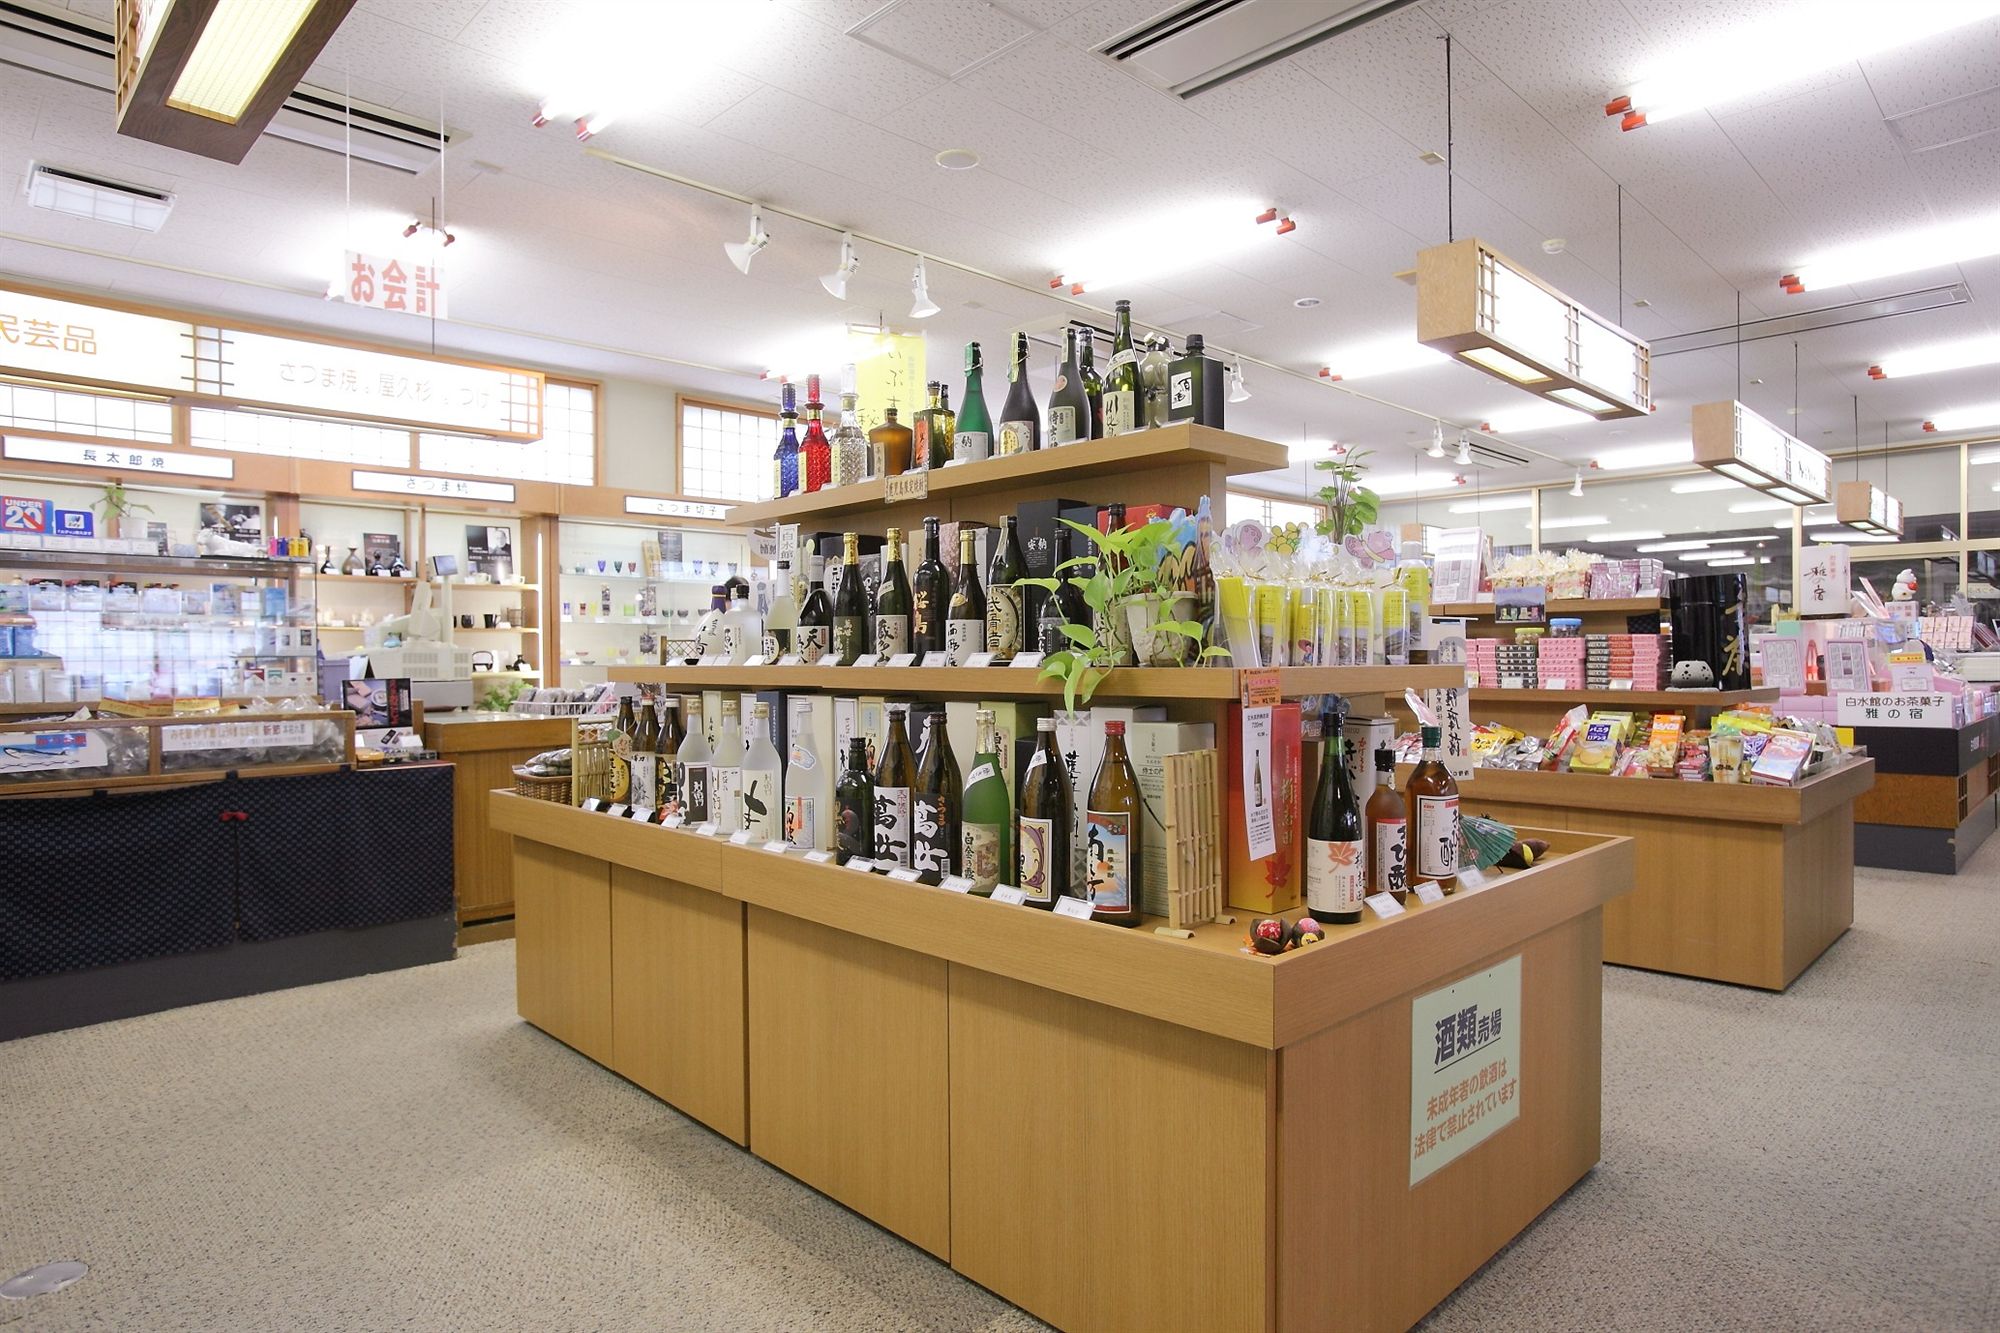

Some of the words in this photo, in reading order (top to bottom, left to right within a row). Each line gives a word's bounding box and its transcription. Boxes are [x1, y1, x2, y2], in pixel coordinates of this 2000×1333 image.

[351, 253, 440, 318] お会計
[83, 449, 165, 468] 長太郎焼
[407, 476, 469, 494] さつま焼
[5, 499, 43, 509] UNDER
[5, 505, 43, 530] 20
[1845, 696, 1945, 707] 白水館のお茶菓子
[1866, 708, 1923, 720] 雅の宿
[1434, 1004, 1502, 1066] 酒類売場
[1427, 1057, 1507, 1121] 未成年者の飲酒は
[1414, 1078, 1518, 1160] 法律で禁止されています
